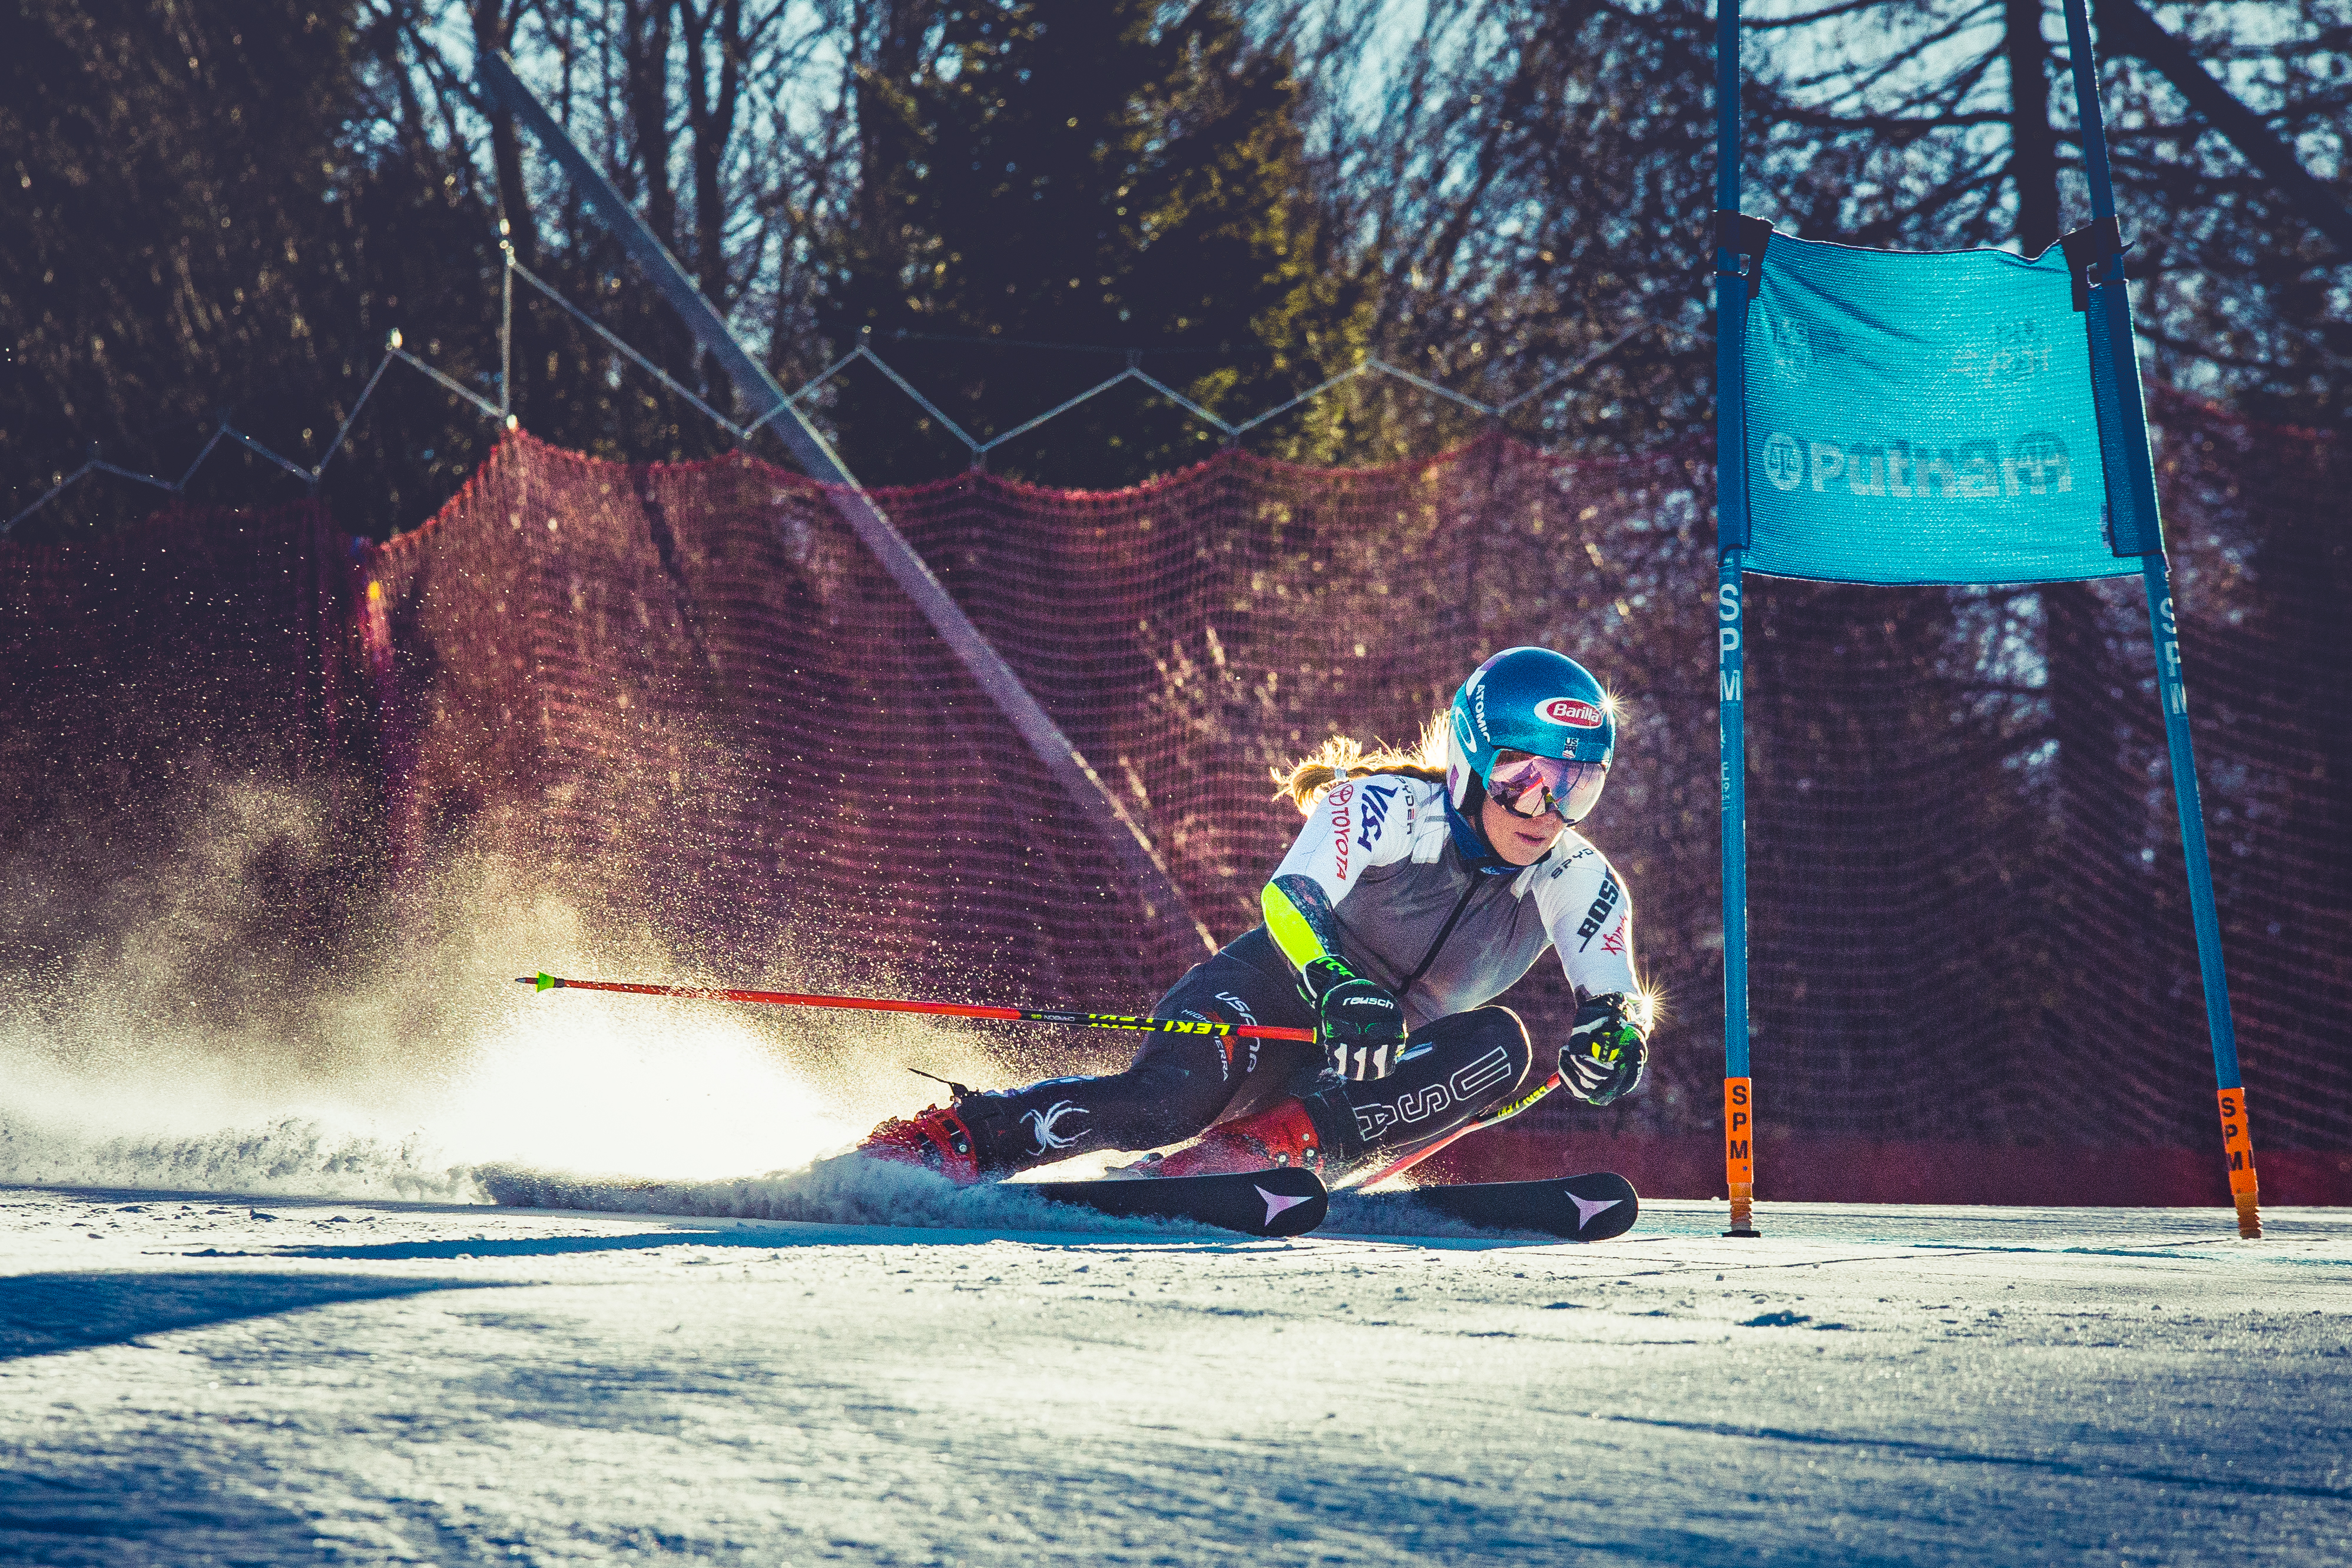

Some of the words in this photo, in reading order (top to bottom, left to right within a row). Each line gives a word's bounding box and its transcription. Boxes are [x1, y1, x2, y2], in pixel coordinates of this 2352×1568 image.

[1718, 583, 1741, 701] SPM
[1552, 703, 1600, 723] Barilla
[1565, 737, 1578, 746] US
[1357, 784, 1399, 853] VISA
[1390, 774, 1415, 835] PYDER
[1331, 807, 1351, 881] TOYOTA
[1551, 848, 1595, 880] SPYD
[1342, 996, 1394, 1010] reusch
[1162, 1020, 1231, 1036] LEKI
[1213, 1036, 1228, 1082] IERRA
[1352, 1045, 1512, 1142] USA
